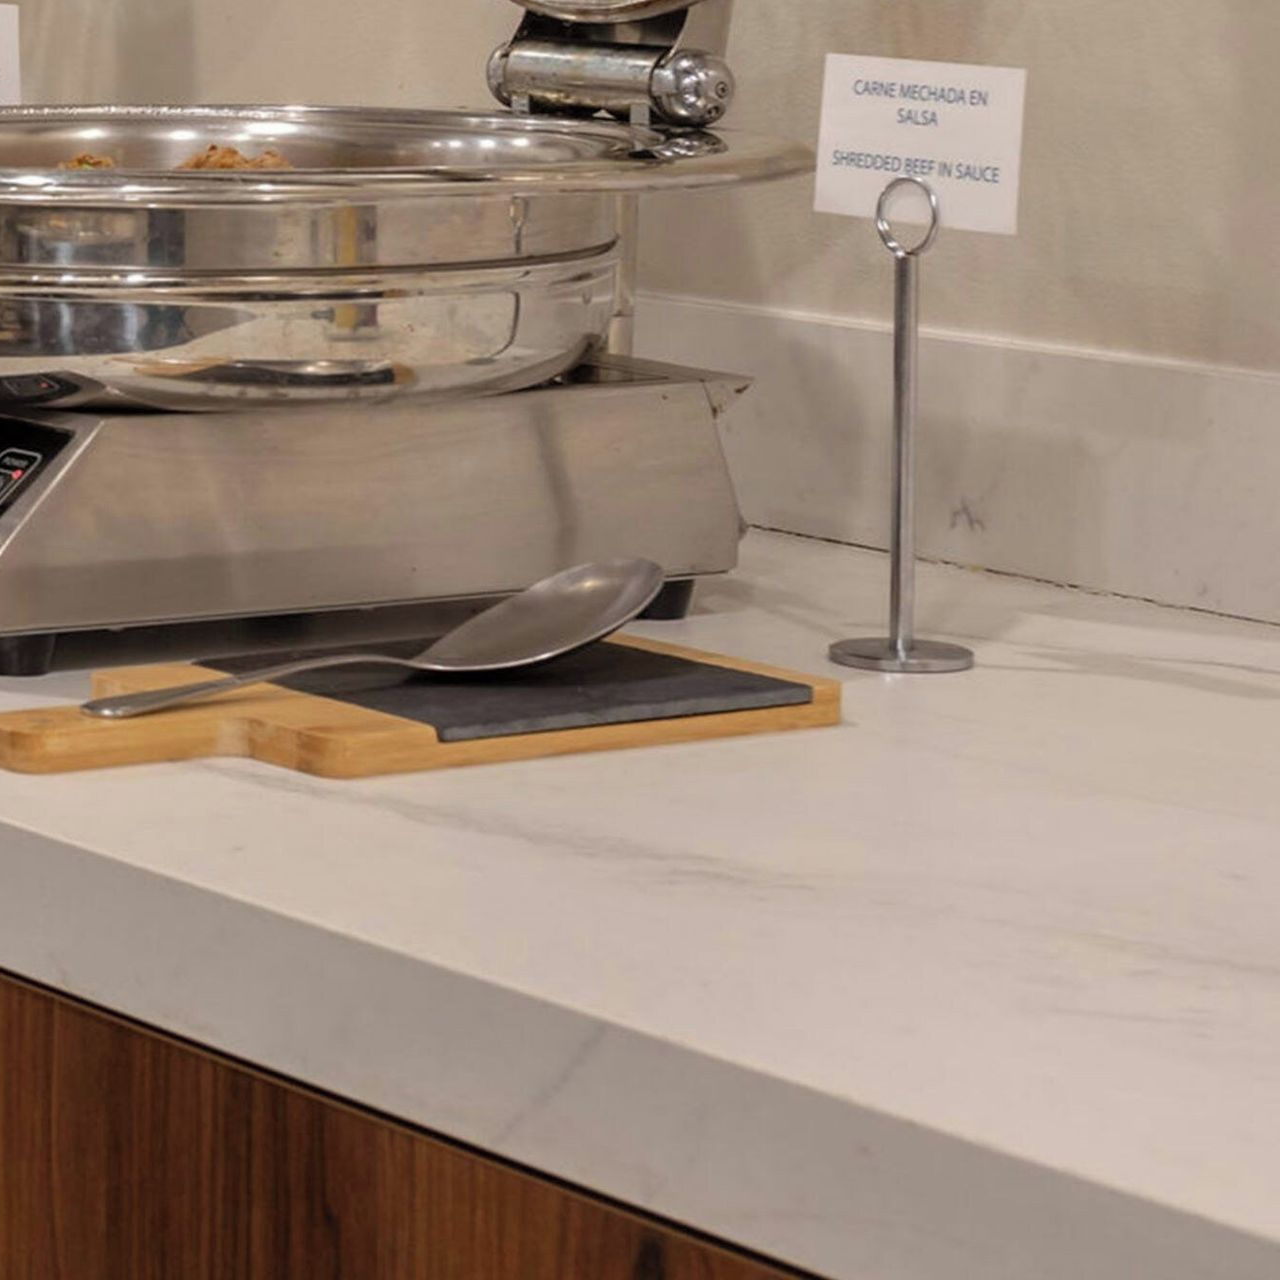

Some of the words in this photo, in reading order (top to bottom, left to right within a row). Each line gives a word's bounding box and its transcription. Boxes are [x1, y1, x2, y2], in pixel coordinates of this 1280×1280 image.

[853, 79, 896, 98] CARNE
[898, 85, 967, 105] MECHADA
[969, 90, 989, 106] EN
[896, 107, 938, 126] SALSA
[832, 150, 902, 173] SHREDDED
[903, 158, 936, 176] BEEF
[938, 163, 953, 178] IN
[955, 163, 1000, 183] SAUCE
